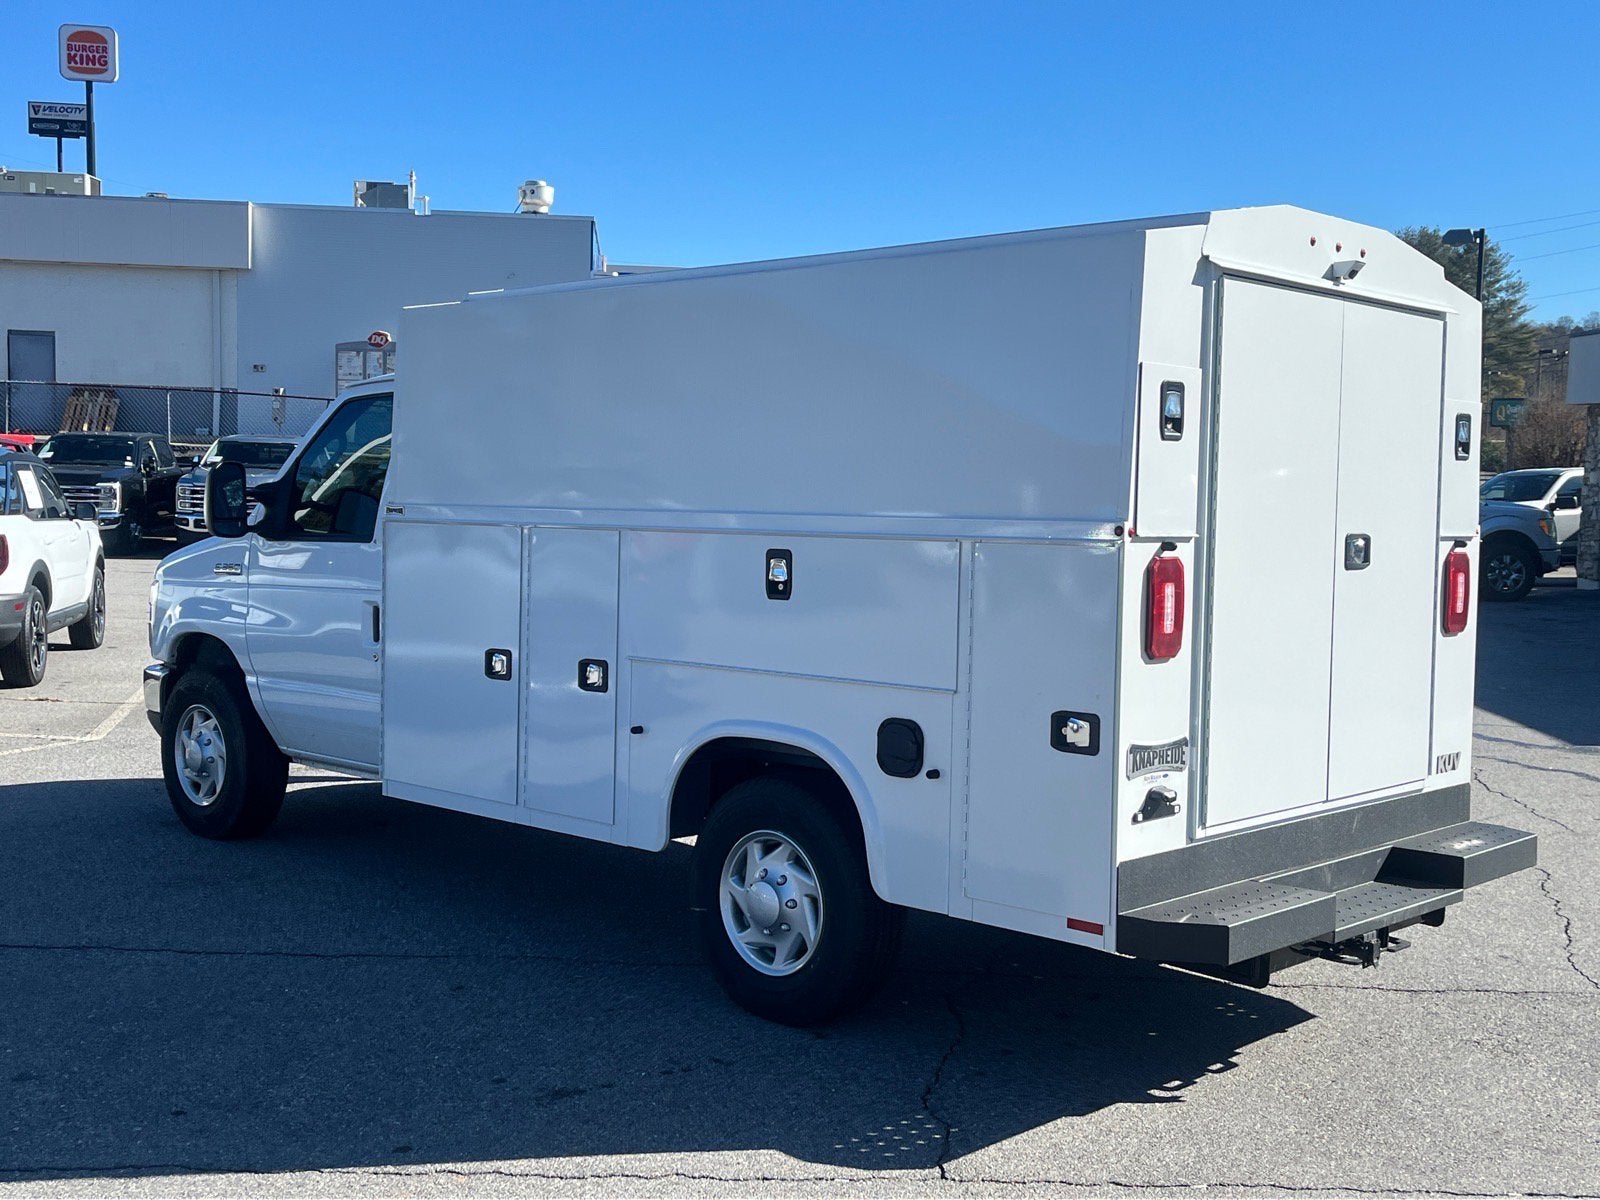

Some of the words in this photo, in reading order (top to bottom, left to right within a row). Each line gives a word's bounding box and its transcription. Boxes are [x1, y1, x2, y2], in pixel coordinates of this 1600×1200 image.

[66, 43, 108, 54] BURGER
[67, 53, 108, 67] KING
[42, 104, 86, 115] VELOCITY
[371, 334, 387, 345] DQ
[1131, 744, 1186, 774] KNAPHEIDE
[1436, 751, 1461, 774] KUV
